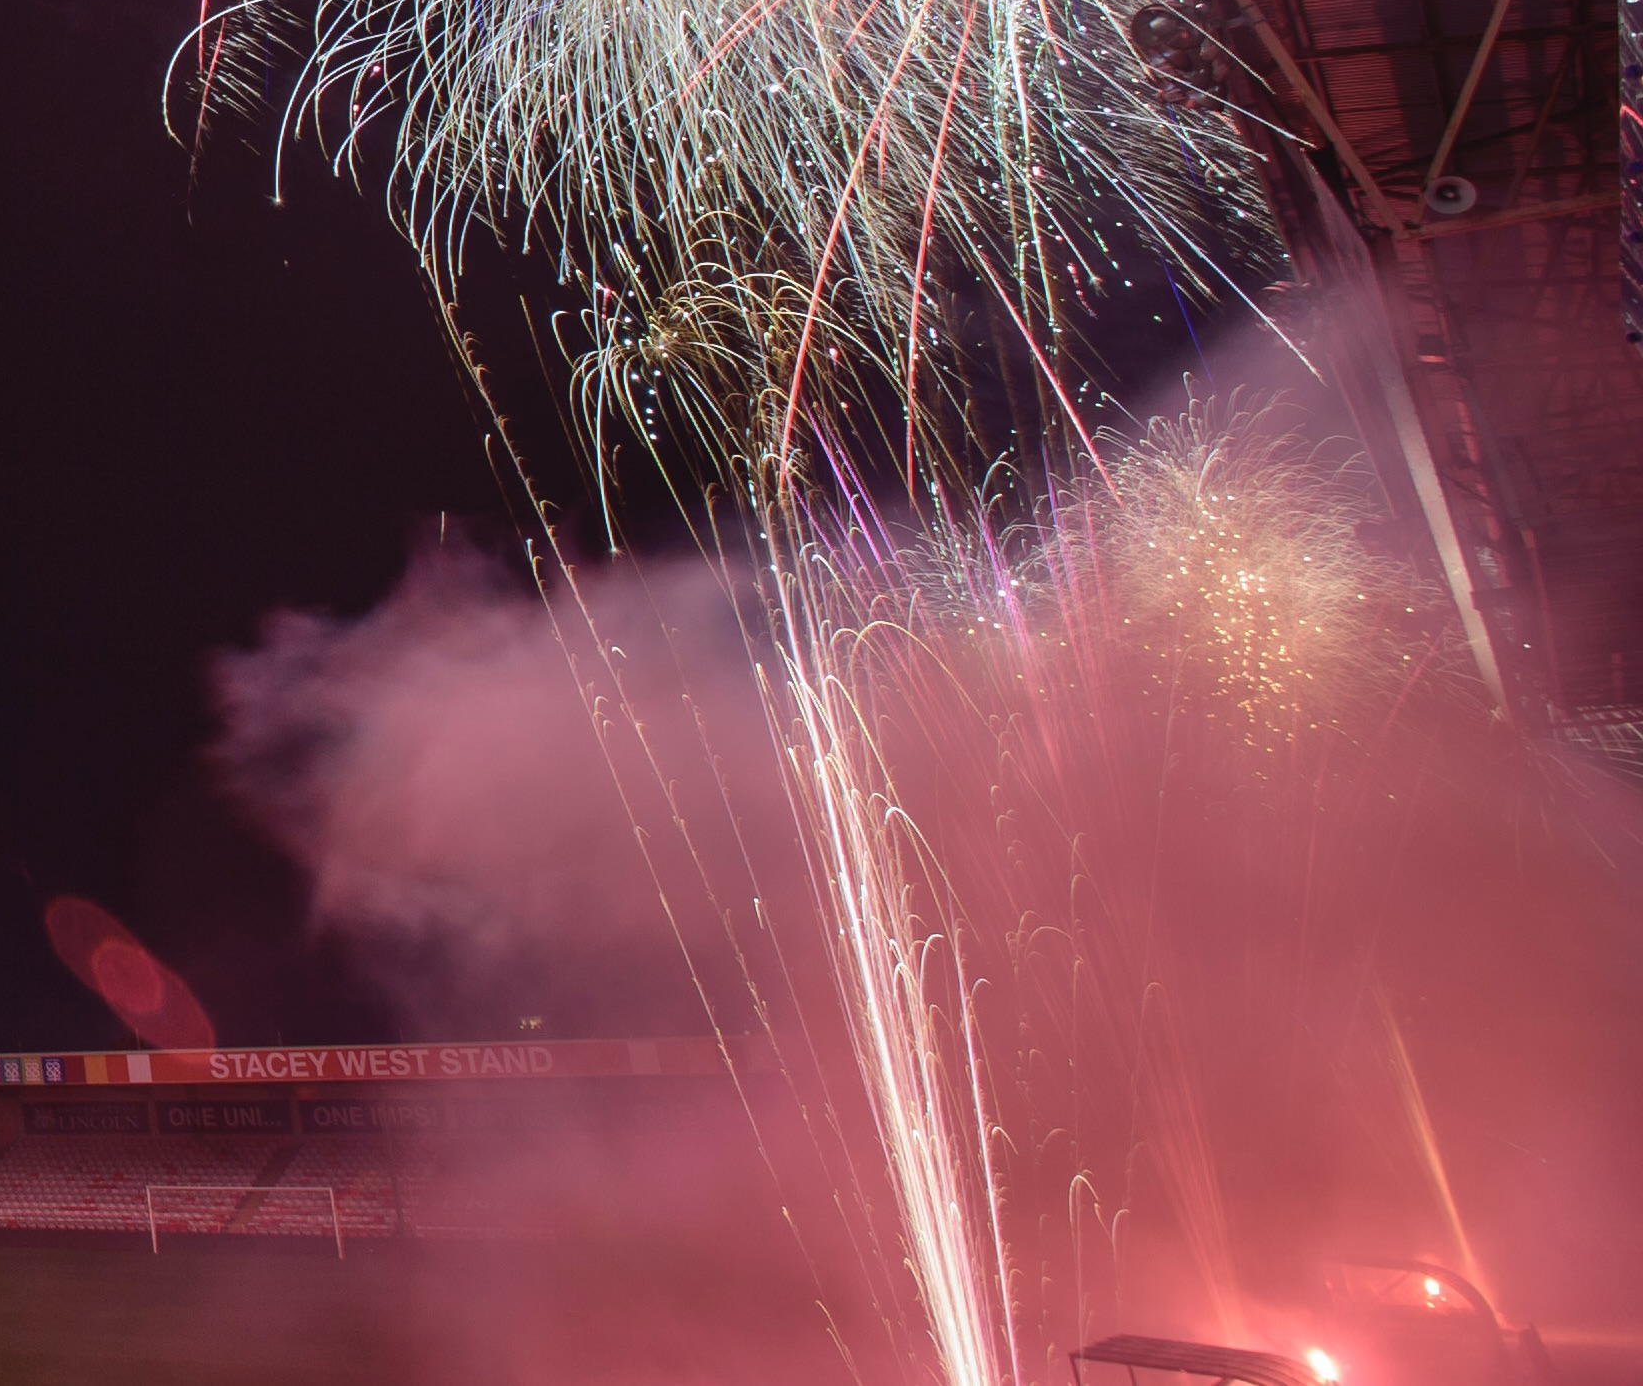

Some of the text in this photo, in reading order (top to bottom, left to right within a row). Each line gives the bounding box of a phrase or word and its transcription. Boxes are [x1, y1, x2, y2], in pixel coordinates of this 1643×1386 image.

[209, 1046, 554, 1080] STACEY WEST STAND
[59, 1115, 140, 1130] LINCOLN
[168, 1107, 218, 1127] ONE
[314, 1106, 365, 1127] ONE
